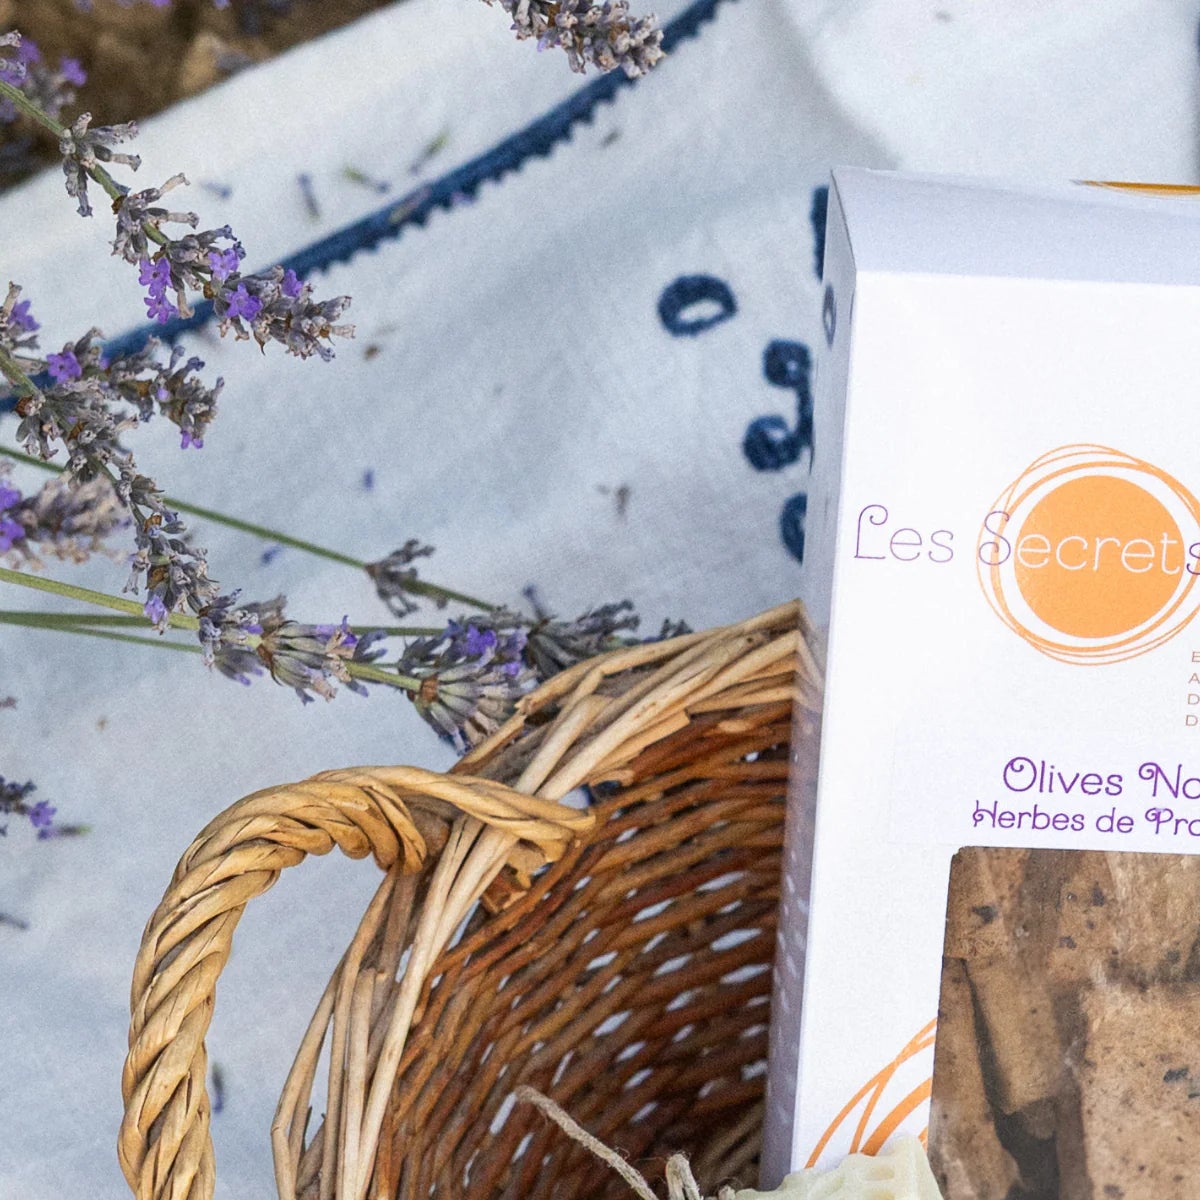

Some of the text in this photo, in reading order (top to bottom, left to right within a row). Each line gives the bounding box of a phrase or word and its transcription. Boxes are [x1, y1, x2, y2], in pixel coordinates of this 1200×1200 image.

[853, 504, 955, 565] Les
[1003, 756, 1123, 796] Olives
[972, 800, 1085, 832] Herbes
[1096, 807, 1134, 833] de
